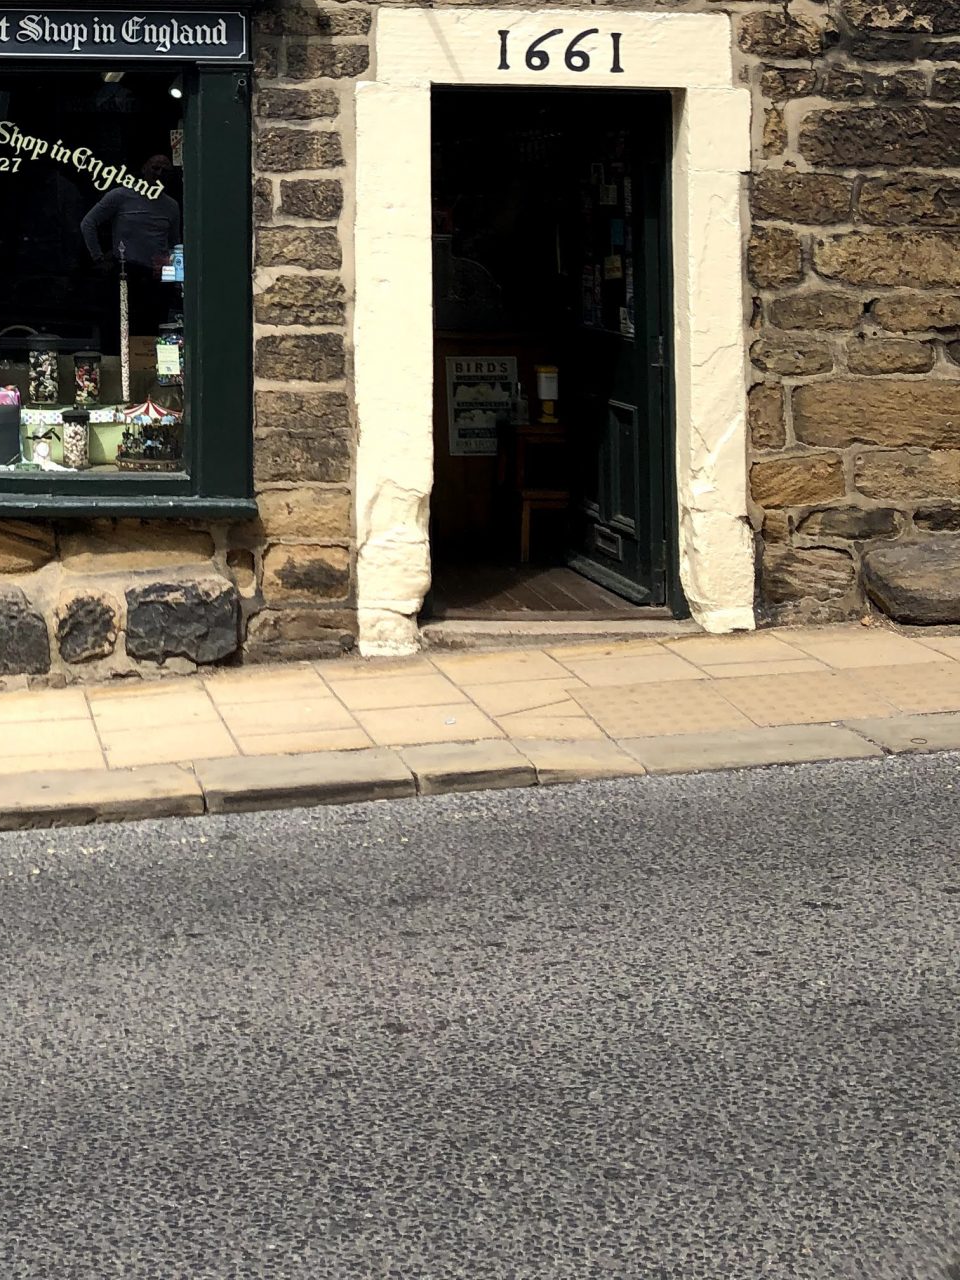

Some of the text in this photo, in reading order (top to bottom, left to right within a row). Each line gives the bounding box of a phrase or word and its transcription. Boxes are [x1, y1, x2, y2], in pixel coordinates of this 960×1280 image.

[16, 14, 88, 51] Shop
[93, 16, 117, 43] in
[121, 16, 228, 52] England
[497, 28, 625, 73] 1661
[50, 139, 70, 164] in
[72, 147, 165, 200] England
[454, 361, 509, 374] BIRDS
